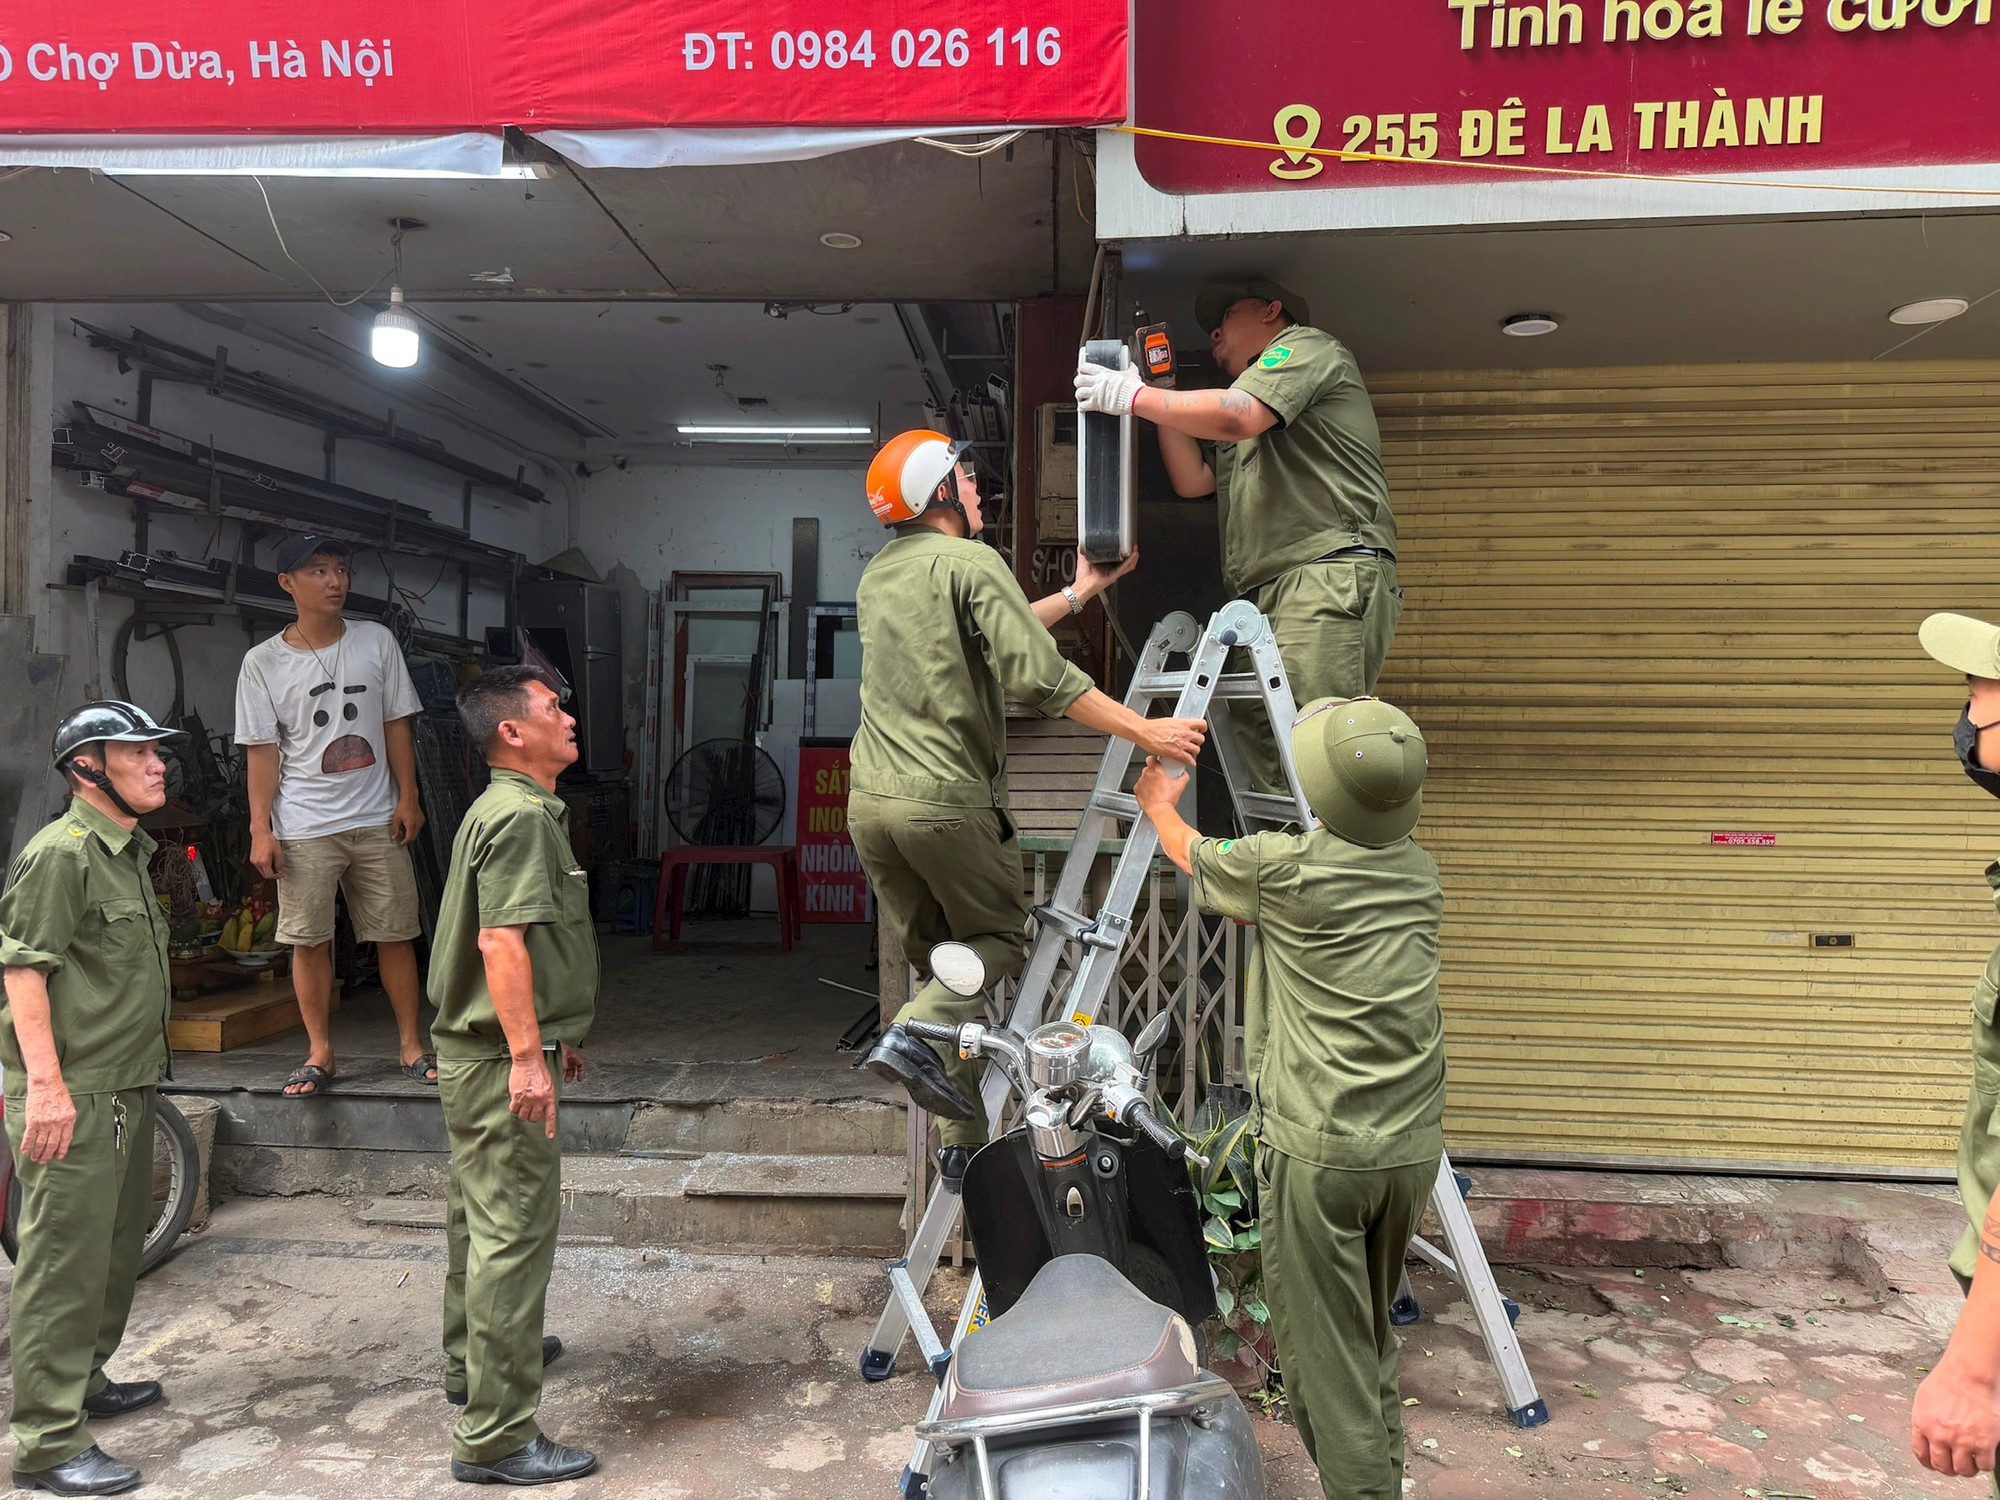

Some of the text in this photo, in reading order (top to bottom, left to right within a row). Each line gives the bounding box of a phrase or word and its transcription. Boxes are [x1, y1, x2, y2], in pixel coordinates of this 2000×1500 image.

[681, 26, 1061, 71] ĐT: 0984 026 116
[1448, 0, 1583, 50] Tinh
[1603, 0, 1723, 42] hoa
[27, 42, 119, 91] Chợ
[131, 40, 235, 86] Dừa,
[250, 39, 307, 79] Hà
[321, 38, 393, 87] Nội
[1341, 87, 1823, 162] 255 ĐÊ LA THÀNH
[801, 838, 862, 873] NHÔM
[805, 878, 855, 912] KÍNH
